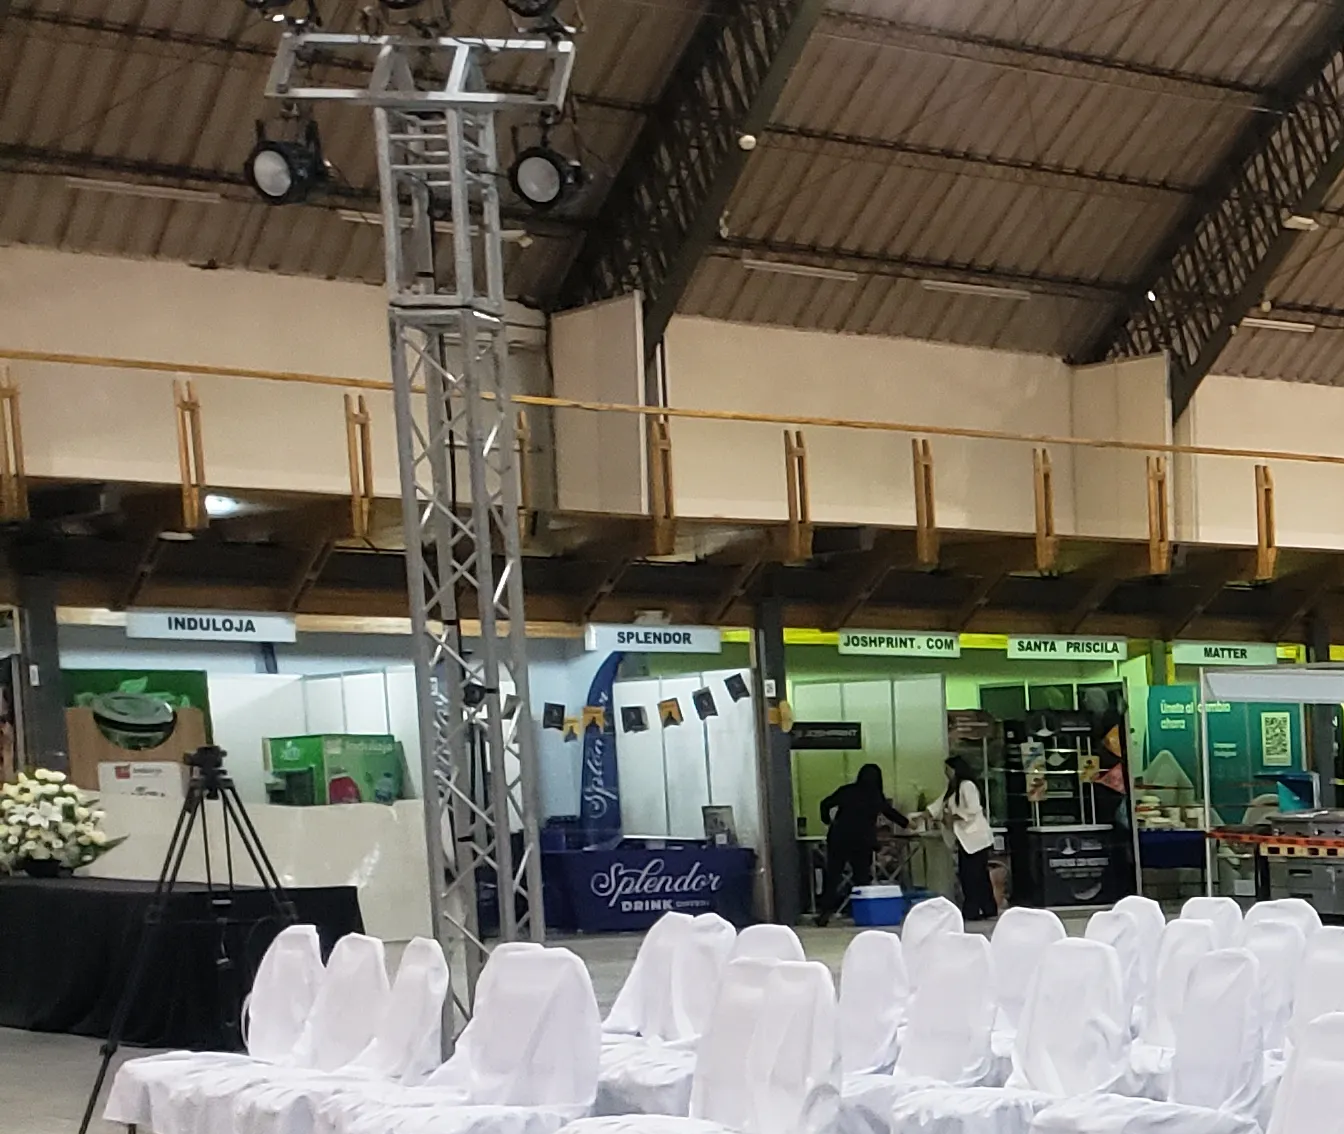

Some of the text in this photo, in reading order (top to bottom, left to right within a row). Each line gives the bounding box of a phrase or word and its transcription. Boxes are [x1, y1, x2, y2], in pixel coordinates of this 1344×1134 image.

[167, 616, 257, 633] INDULOJA
[617, 631, 693, 645] SPLENDOR
[1017, 640, 1119, 654] SANTA PRISCILA
[1203, 647, 1248, 660] MATTER
[590, 857, 721, 908] Splendor
[620, 899, 674, 912] DRINK
